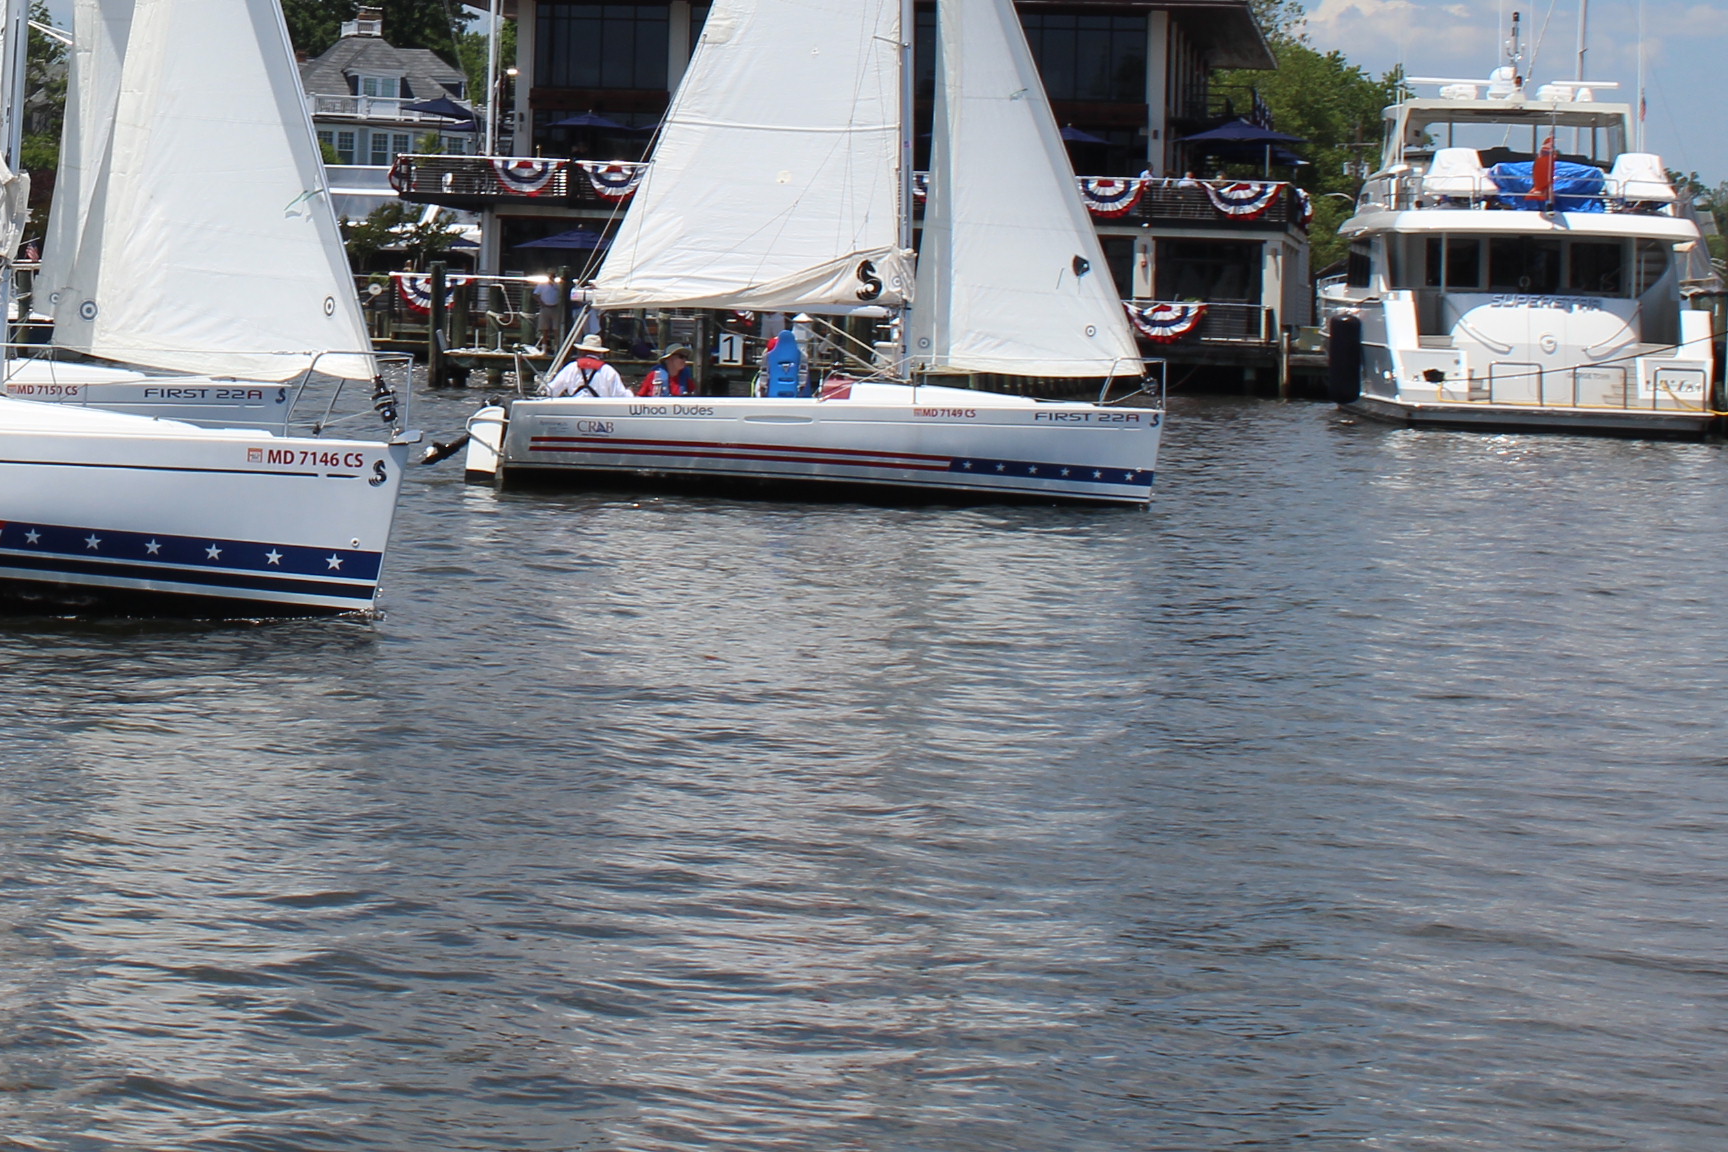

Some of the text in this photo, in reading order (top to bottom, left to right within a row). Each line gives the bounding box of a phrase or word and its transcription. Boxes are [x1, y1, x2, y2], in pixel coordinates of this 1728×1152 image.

[723, 336, 738, 363] 1
[17, 385, 78, 396] MD 7150 CS
[144, 388, 262, 400] FIRST 22A
[629, 404, 714, 416] Whoa Dudes
[923, 408, 976, 418] MD 7149 CS
[1035, 412, 1140, 422] FIRST 22A
[576, 420, 614, 433] CRAB
[267, 449, 363, 467] MD 7146 CS
